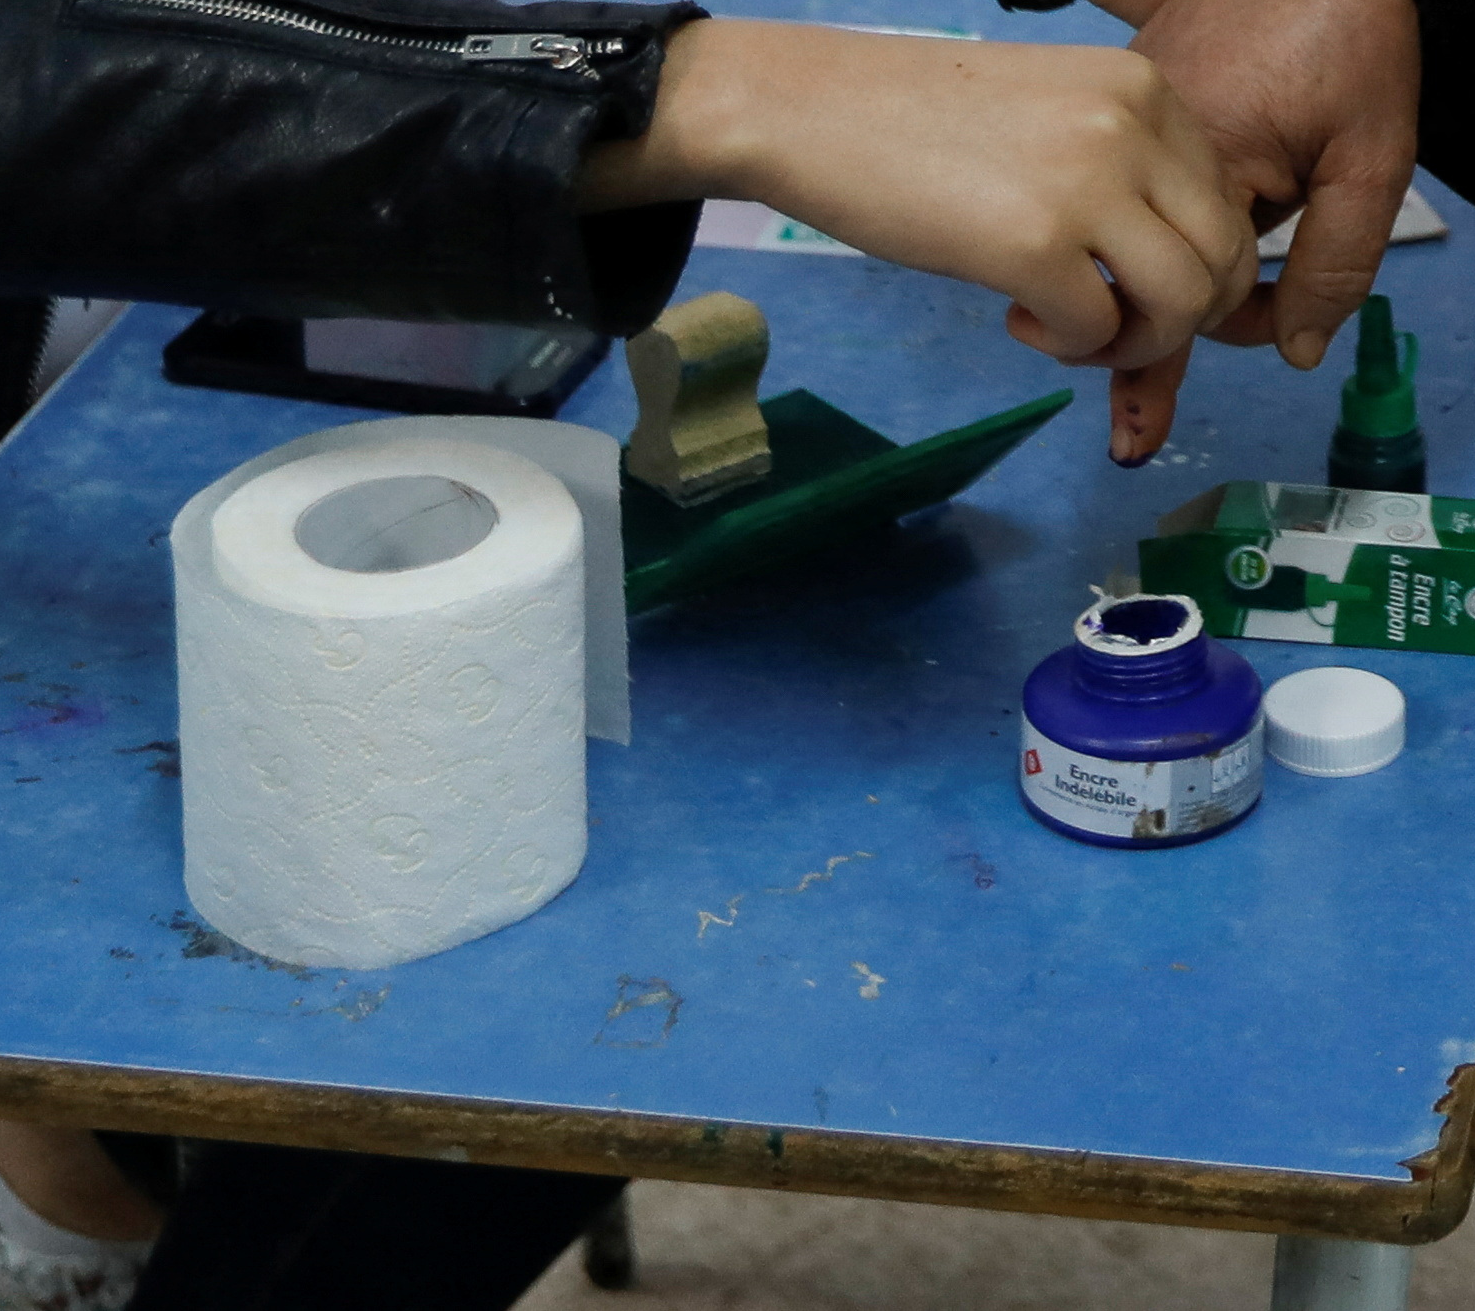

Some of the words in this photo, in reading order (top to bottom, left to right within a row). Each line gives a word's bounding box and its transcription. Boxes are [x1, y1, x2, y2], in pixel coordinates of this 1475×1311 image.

[1389, 554, 1412, 567] à
[1384, 569, 1409, 642] tampon
[1412, 573, 1436, 626] Encre
[1069, 764, 1119, 788] Encre
